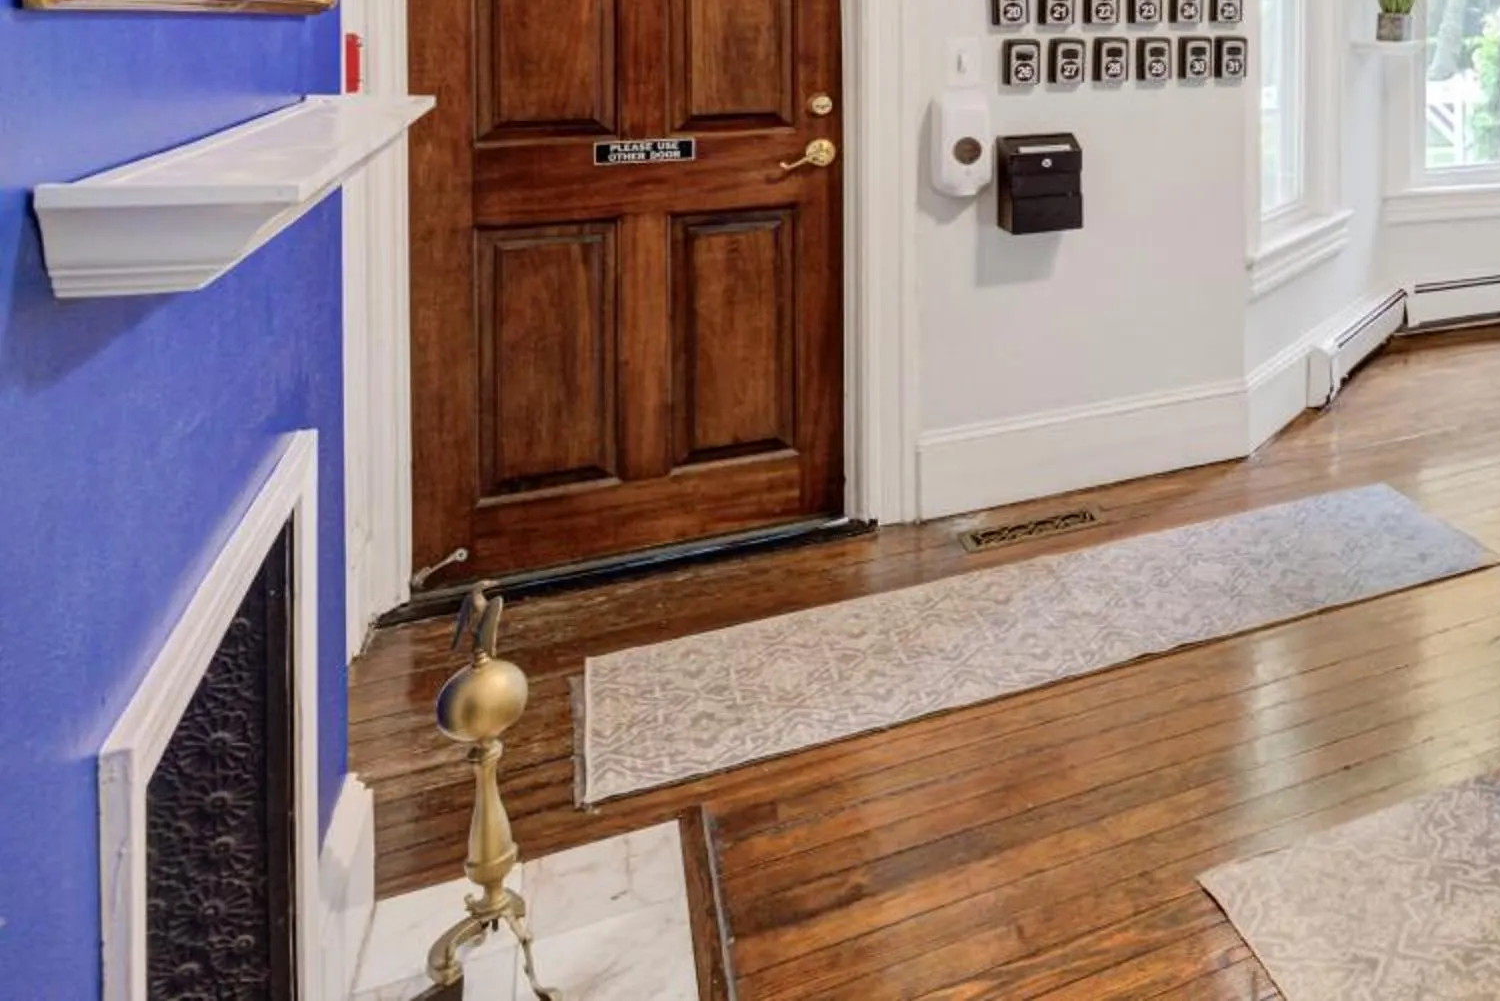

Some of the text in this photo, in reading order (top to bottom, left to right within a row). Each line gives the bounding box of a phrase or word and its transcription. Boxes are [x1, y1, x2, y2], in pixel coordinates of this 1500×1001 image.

[1005, 6, 1021, 18] 20
[1053, 6, 1067, 18] 21
[1098, 6, 1112, 18] 22
[1141, 5, 1154, 16] 23
[1183, 6, 1196, 16] 24
[1223, 6, 1236, 17] 25
[1017, 66, 1032, 78] 26
[1063, 65, 1076, 76] 27
[1151, 63, 1165, 74] 29
[1192, 62, 1205, 72] 30
[1227, 61, 1240, 72] 31
[609, 141, 679, 152] PLEASE USE
[608, 150, 681, 162] OTHER DOOR
